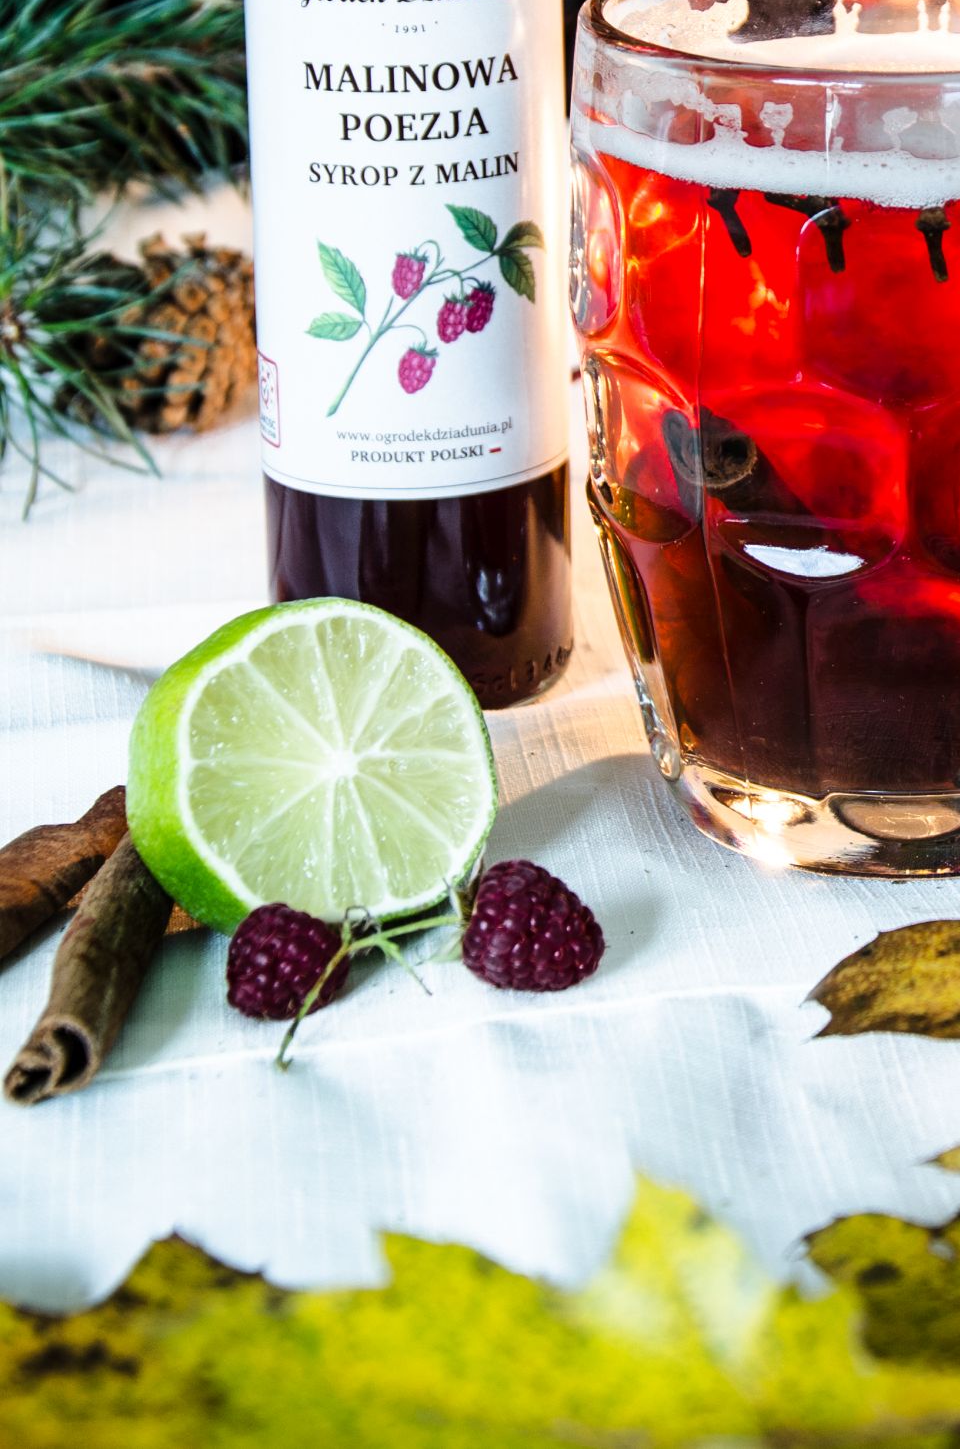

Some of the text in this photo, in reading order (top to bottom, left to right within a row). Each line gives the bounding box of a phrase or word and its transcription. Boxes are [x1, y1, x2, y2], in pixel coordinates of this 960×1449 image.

[395, 24, 426, 34] 1991
[303, 53, 519, 93] MALINOWA
[339, 107, 489, 142] POEZJA
[308, 152, 519, 186] SYROP Z MALIN
[336, 416, 513, 445] www.ogrodekdziadunia.pl
[351, 444, 485, 464] PRODUKT POLSKI
